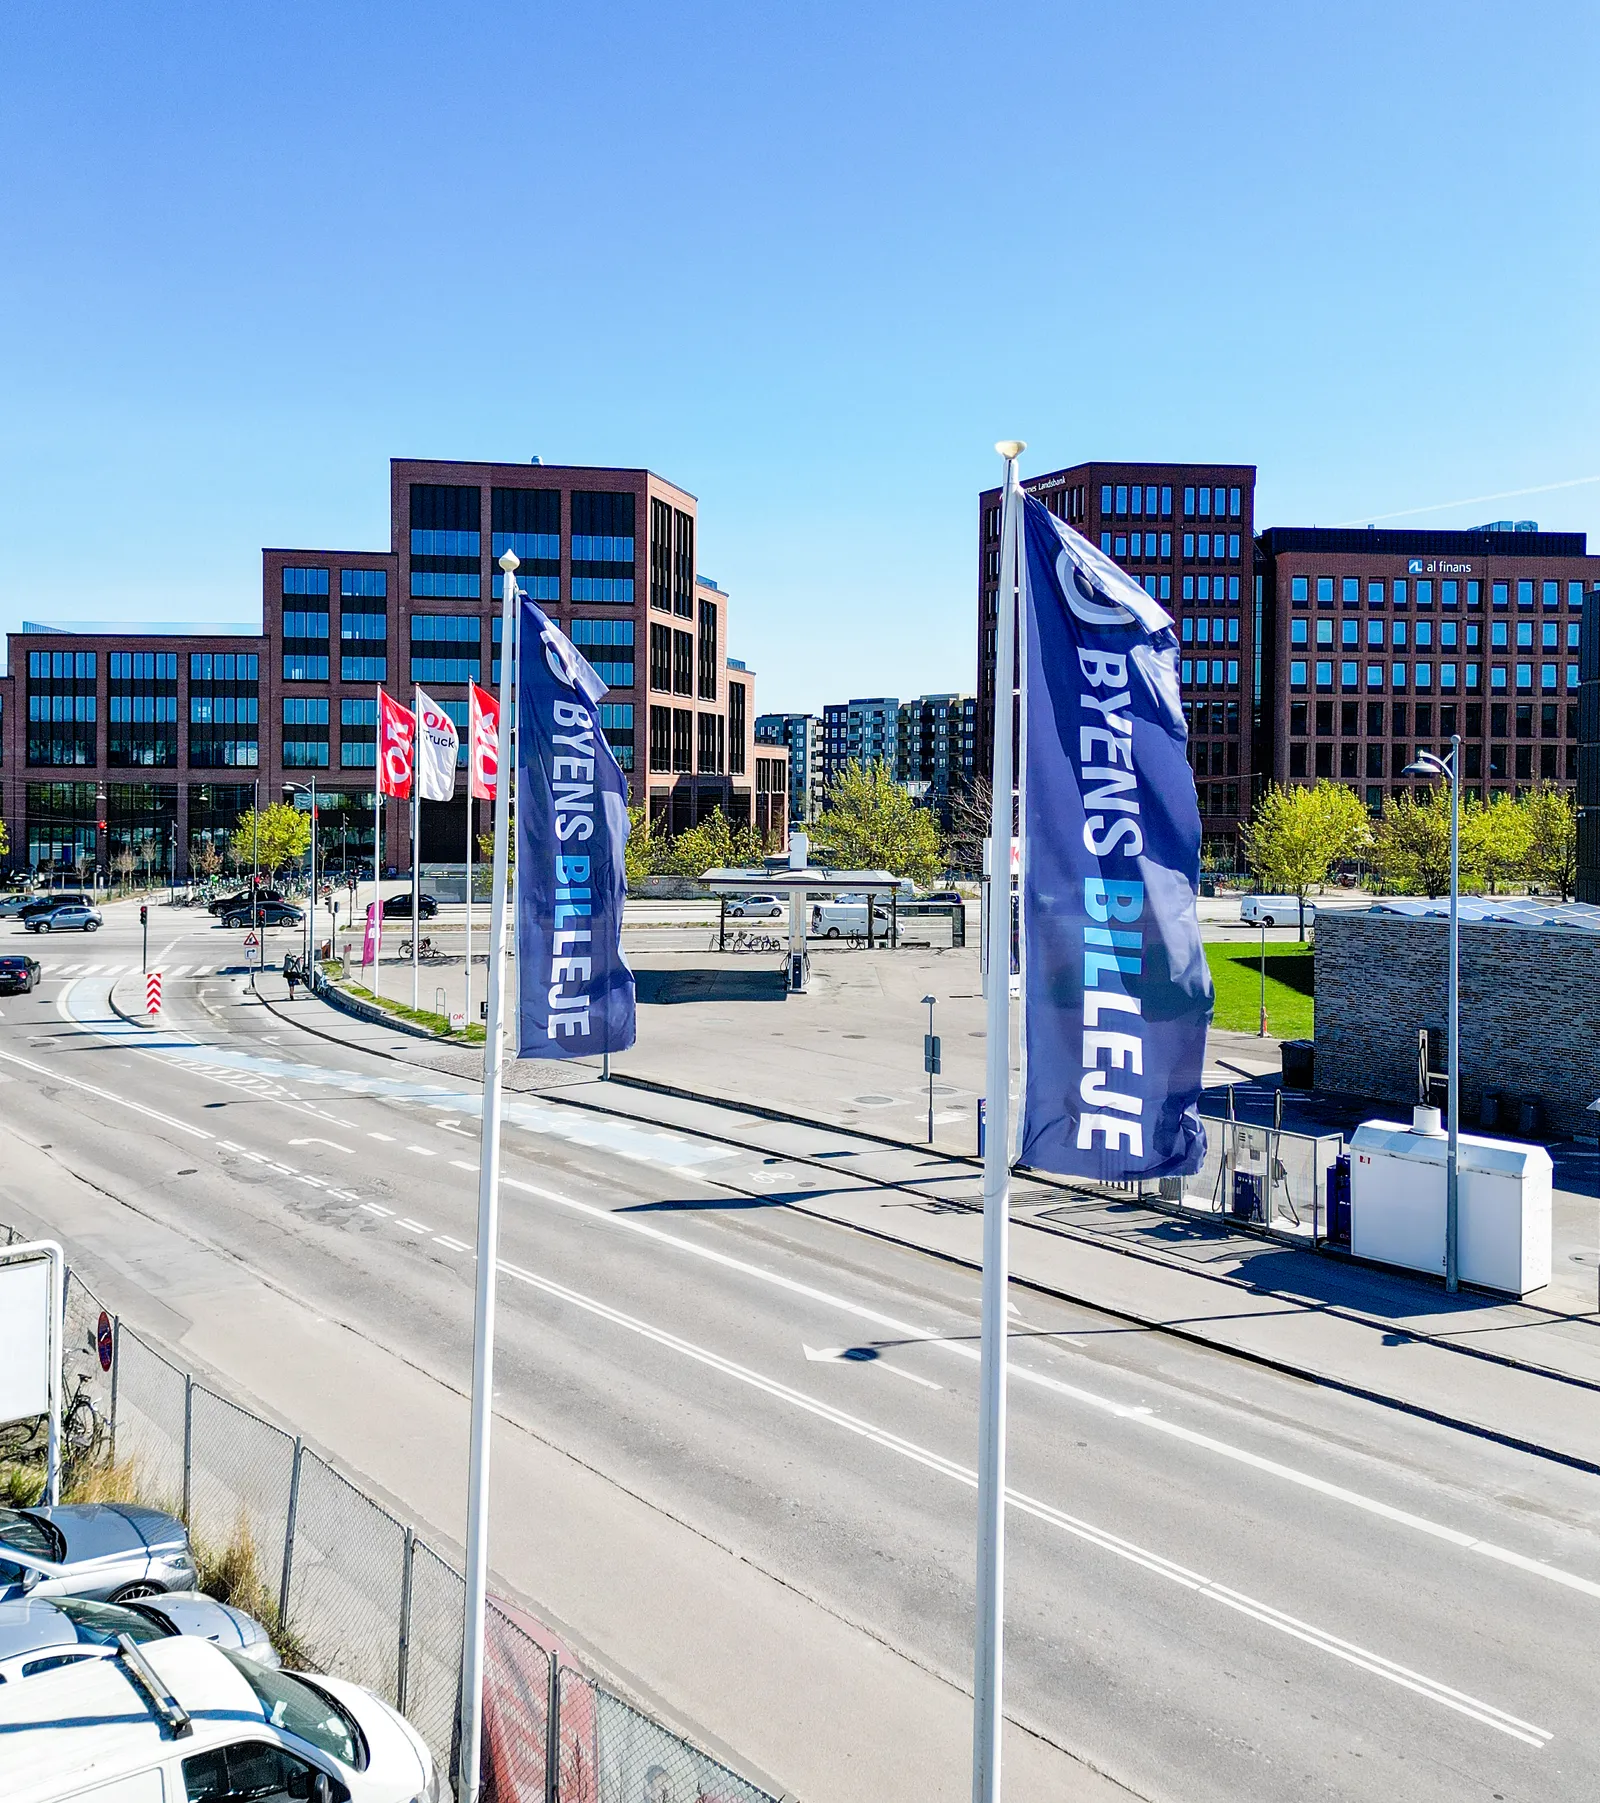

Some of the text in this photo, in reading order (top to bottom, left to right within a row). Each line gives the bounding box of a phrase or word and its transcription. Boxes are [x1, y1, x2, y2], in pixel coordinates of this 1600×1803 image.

[1038, 475, 1066, 490] Landsbank
[1427, 561, 1471, 572] al finans
[423, 730, 455, 748] Truck
[548, 700, 595, 1039] BYENS BILLEJE
[1077, 646, 1144, 1157] BYENS BILLEJE
